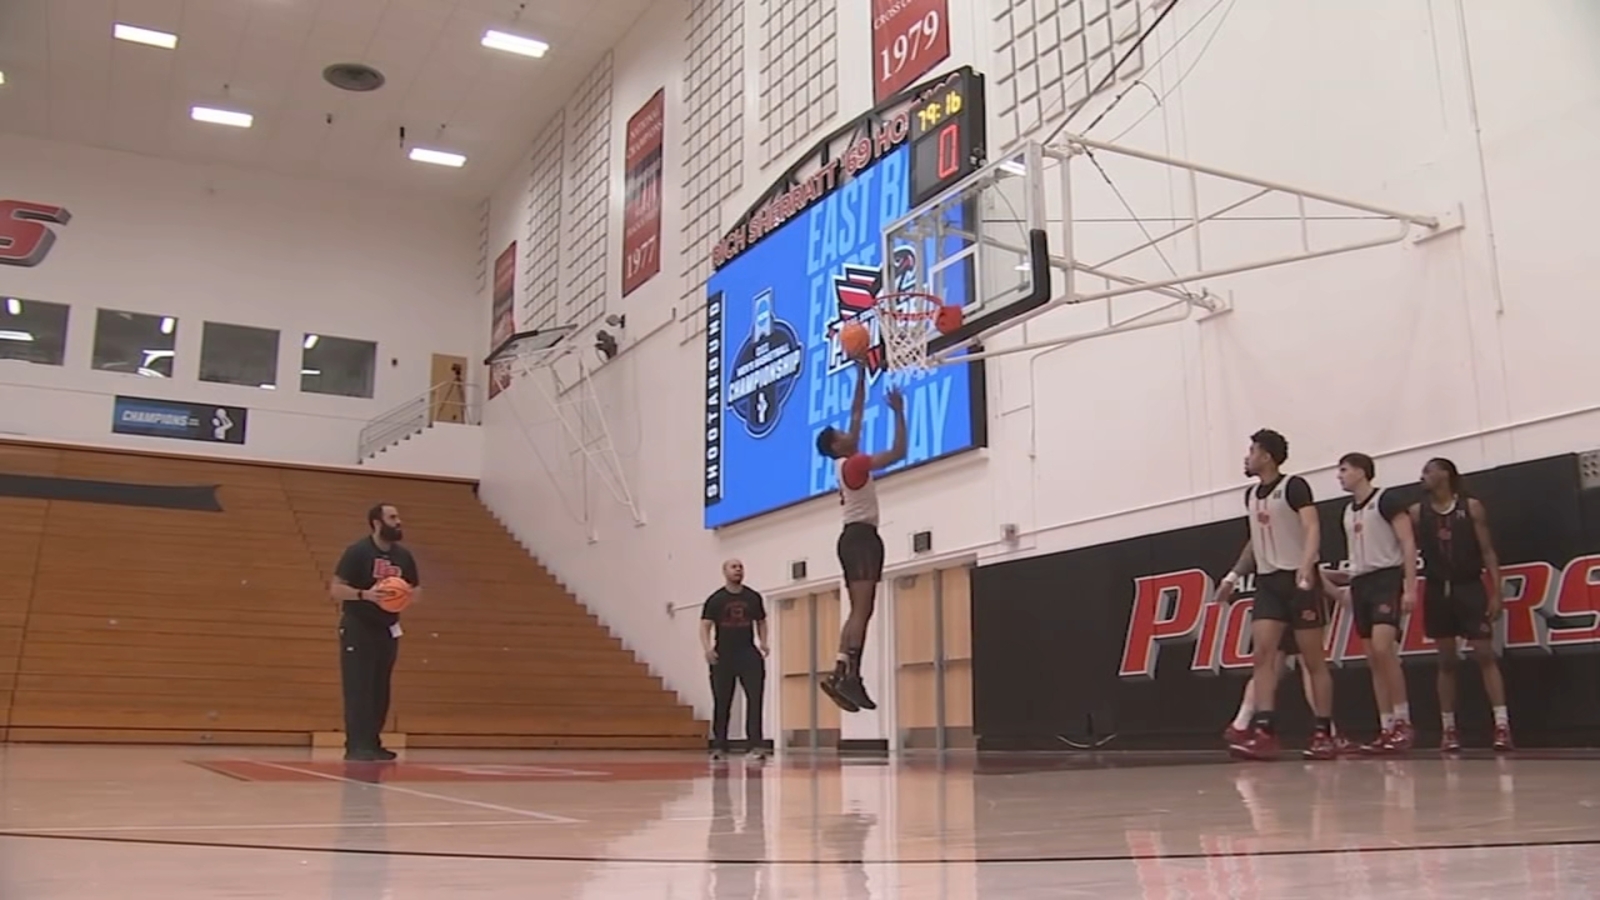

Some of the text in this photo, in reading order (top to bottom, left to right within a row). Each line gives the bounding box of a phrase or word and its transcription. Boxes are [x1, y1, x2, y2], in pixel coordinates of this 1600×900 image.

[880, 10, 939, 83] 1979
[712, 224, 747, 267] RICH
[806, 167, 875, 276] EAST
[626, 234, 658, 280] 1977
